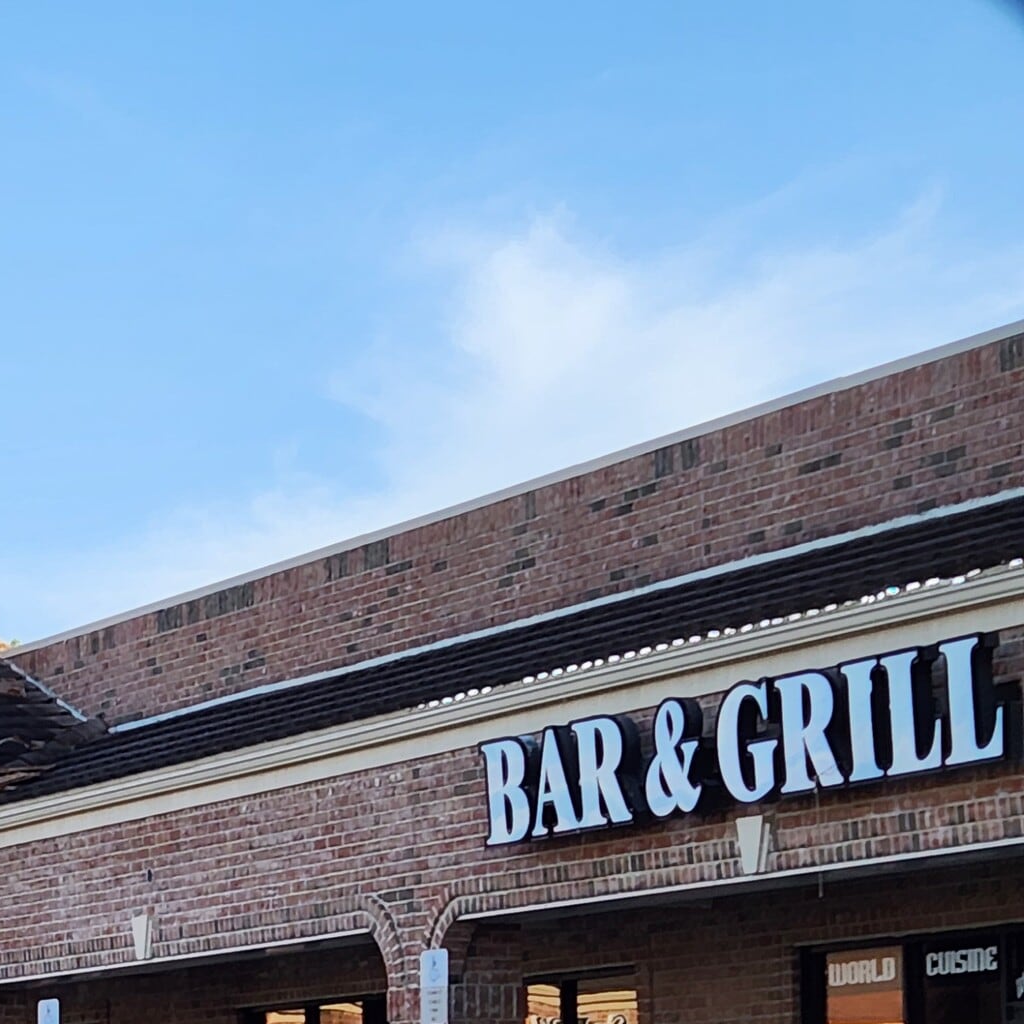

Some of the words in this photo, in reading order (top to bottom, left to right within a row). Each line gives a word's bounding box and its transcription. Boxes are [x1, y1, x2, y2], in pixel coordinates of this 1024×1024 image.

[480, 716, 634, 847] BAR
[645, 699, 703, 818] &
[716, 636, 1004, 803] GRILL
[828, 957, 896, 987] WORLD
[926, 946, 998, 977] CUISINE
